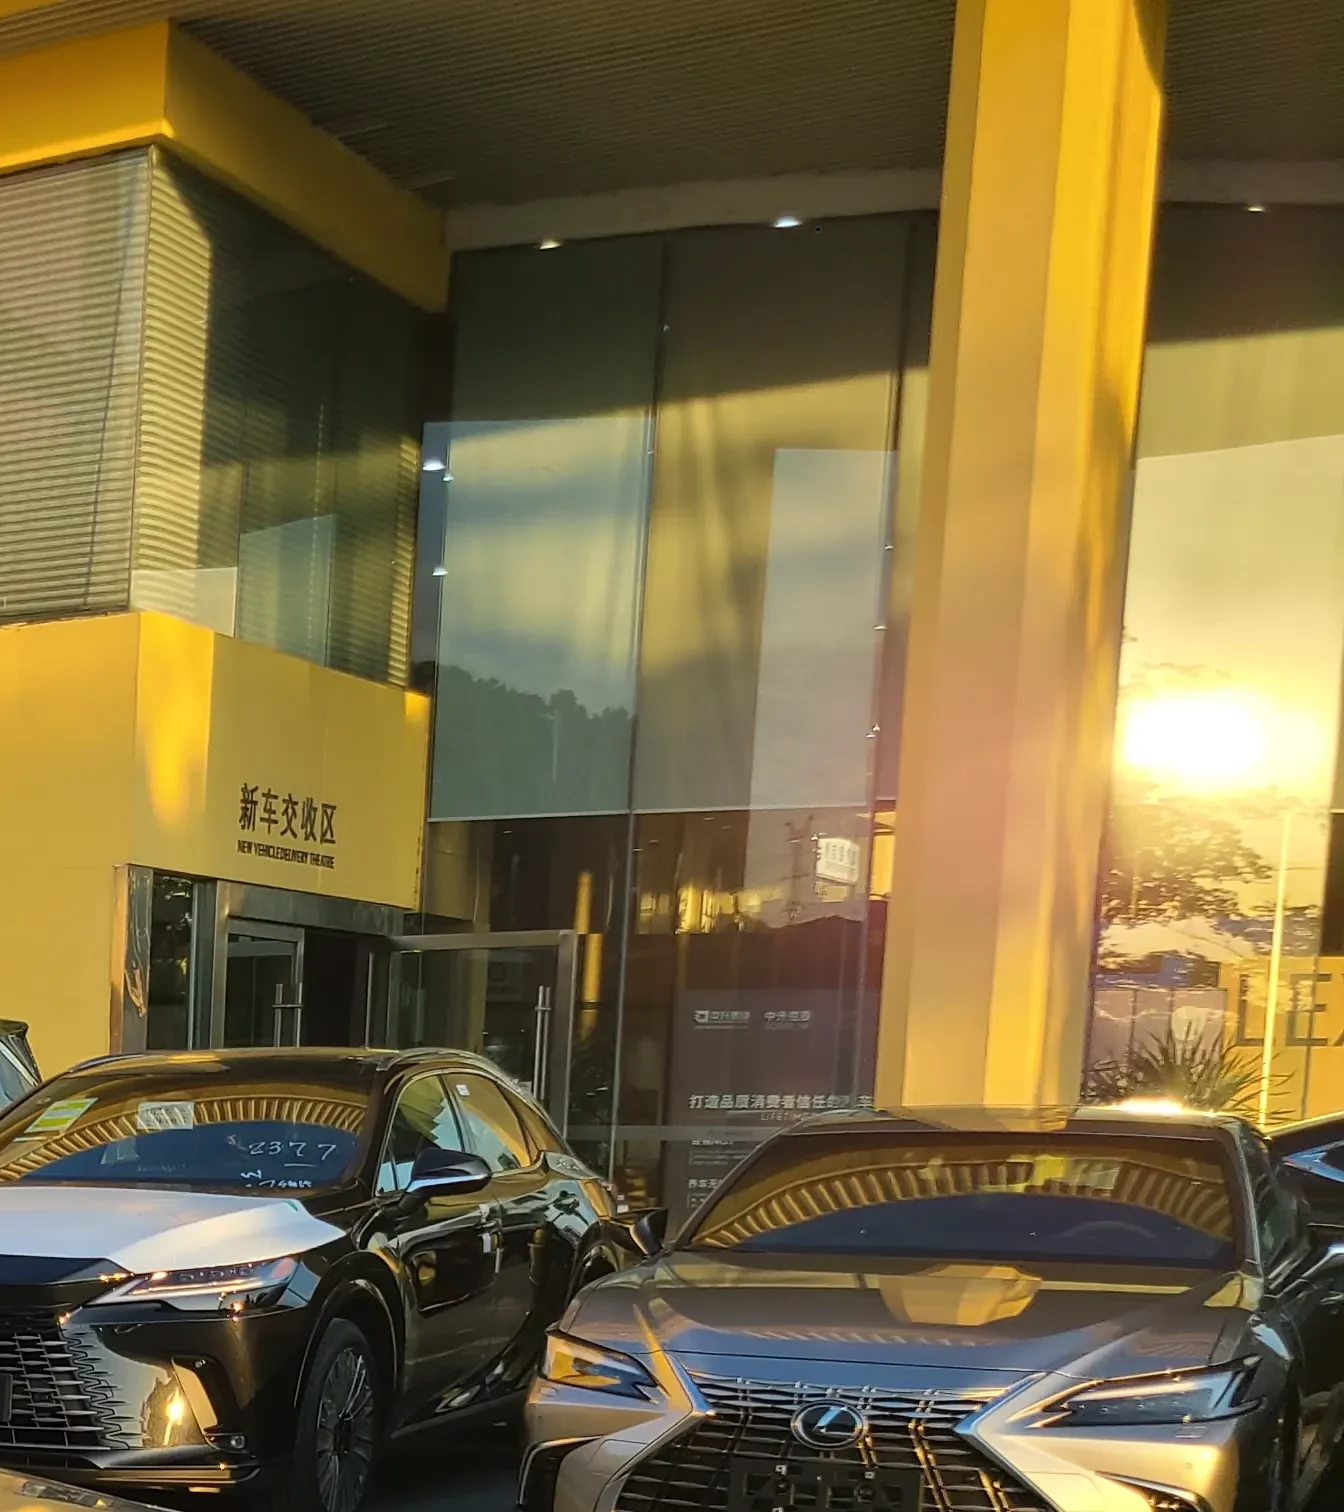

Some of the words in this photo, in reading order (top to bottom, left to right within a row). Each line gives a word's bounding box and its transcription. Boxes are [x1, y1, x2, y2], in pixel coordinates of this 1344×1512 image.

[238, 783, 337, 845] 新车交收区
[237, 840, 253, 854] NEW
